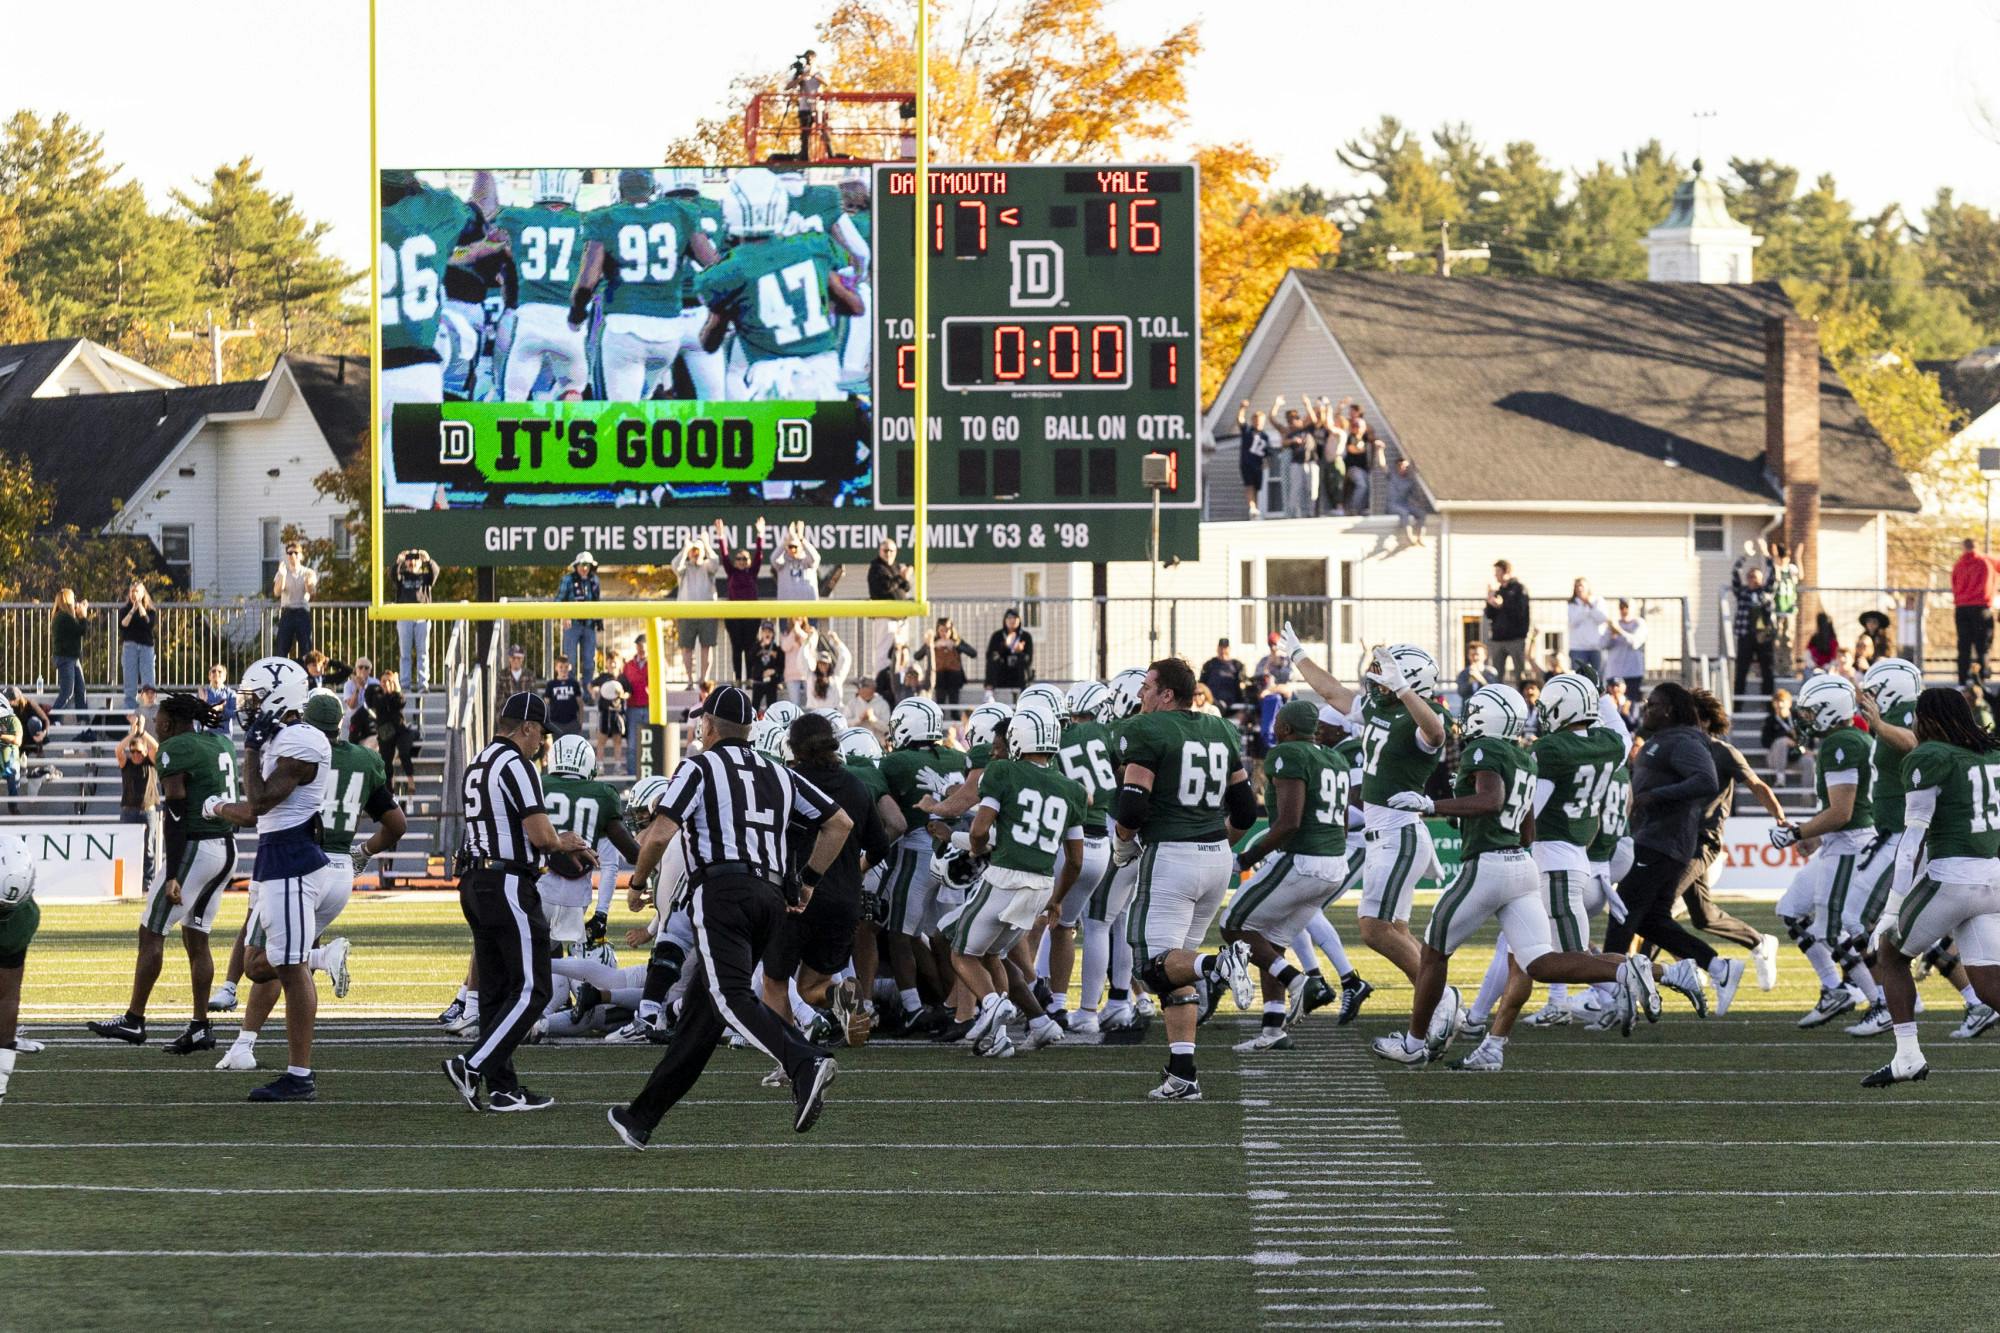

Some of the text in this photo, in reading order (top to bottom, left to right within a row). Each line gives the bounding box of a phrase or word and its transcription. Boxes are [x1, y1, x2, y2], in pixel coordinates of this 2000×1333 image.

[890, 172, 1006, 194] DATMOUTH
[1097, 171, 1149, 193] YALE
[617, 222, 678, 282] 93
[935, 200, 987, 251] 17
[1108, 199, 1161, 252] 16
[520, 226, 576, 281] 37
[1010, 240, 1064, 307] D
[758, 259, 831, 345] 47
[1138, 317, 1189, 339] T.O.L.
[994, 325, 1124, 379] 0:00
[1169, 345, 1177, 385] 1
[440, 420, 474, 465] D
[495, 417, 754, 471] IT'S GOOD
[777, 418, 812, 463] D
[960, 416, 1020, 442] TO GO
[1045, 415, 1126, 441] BALL ON
[1137, 414, 1192, 441] QTR.
[485, 526, 537, 551] GIFT
[543, 526, 574, 551] OF
[580, 526, 625, 550] THE
[986, 523, 1021, 548] '63
[1028, 523, 1046, 548] &
[1053, 523, 1089, 548] '98
[262, 664, 294, 690] Y
[464, 768, 484, 818] S
[1060, 738, 1118, 797] 56
[1178, 740, 1229, 807] 69
[319, 769, 365, 832] 44
[544, 792, 600, 849] 20
[738, 769, 775, 825] L
[1011, 788, 1068, 854] 39
[1315, 768, 1350, 826] 93
